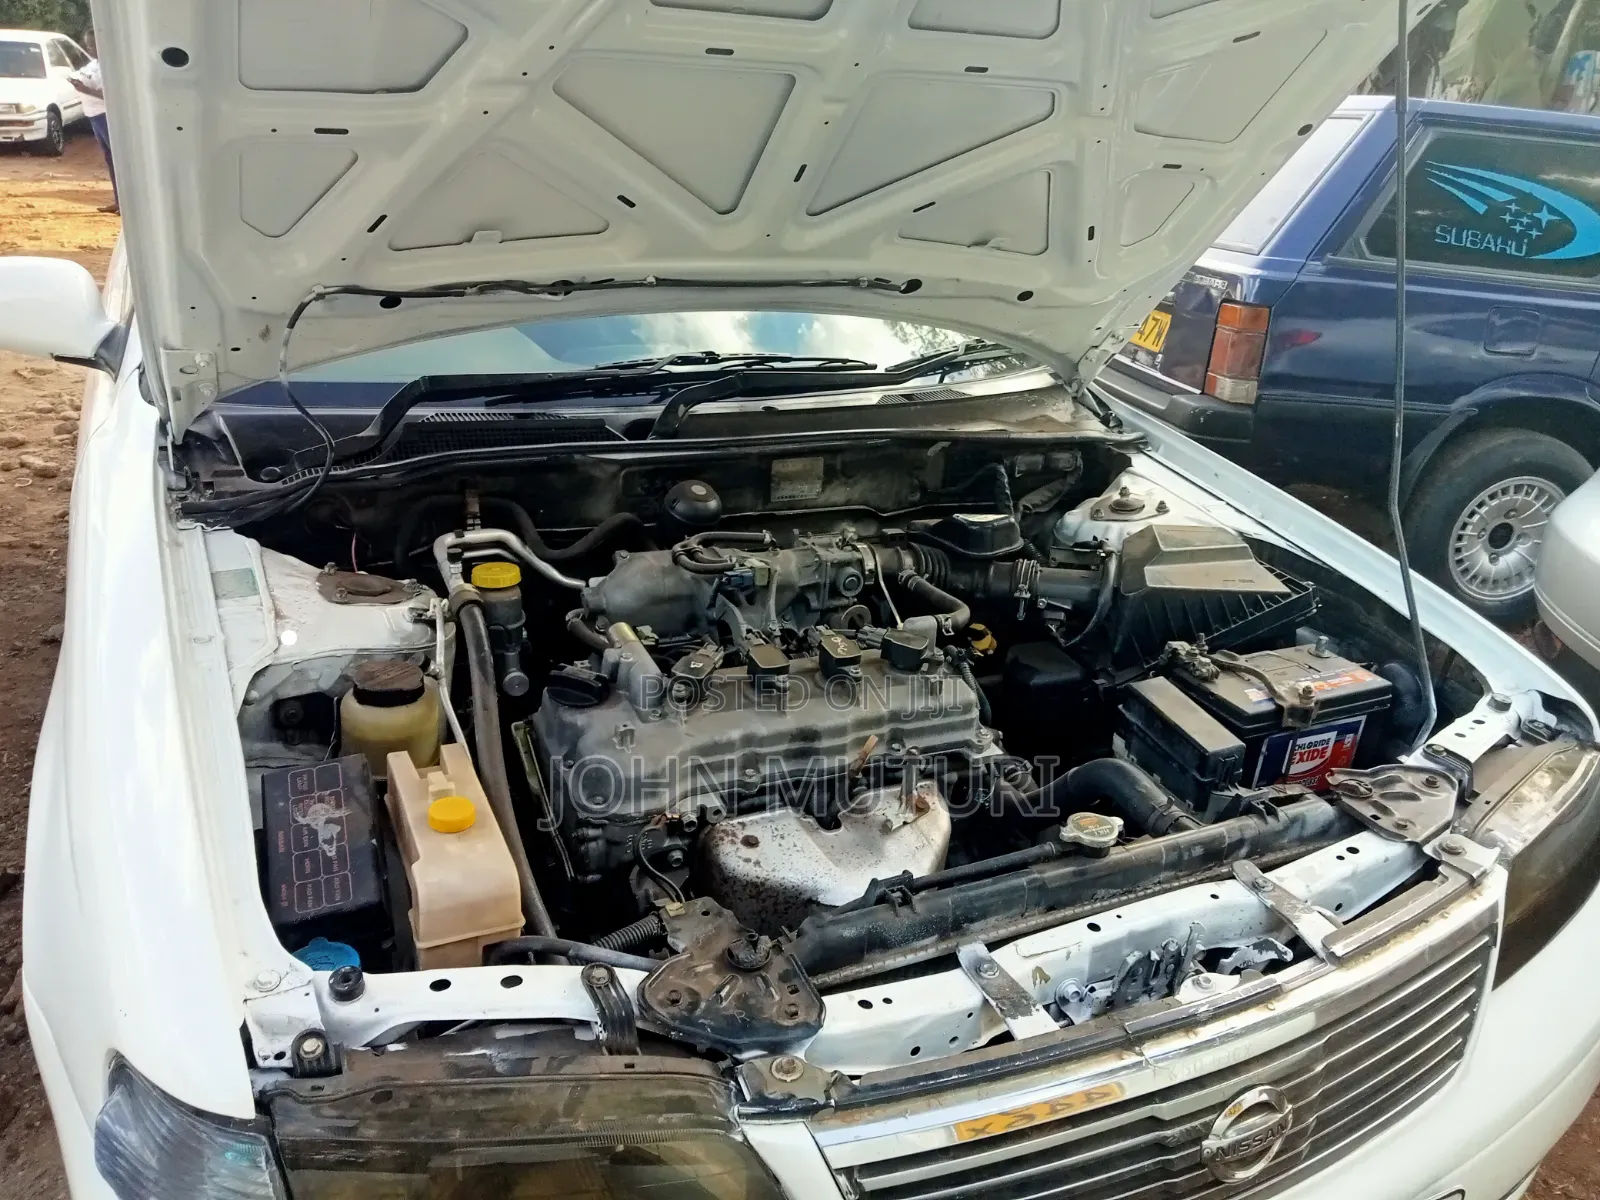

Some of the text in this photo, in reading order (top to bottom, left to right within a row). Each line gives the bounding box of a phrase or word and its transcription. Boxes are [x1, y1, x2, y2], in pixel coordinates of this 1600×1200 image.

[1434, 224, 1528, 257] SUBARU
[1290, 746, 1330, 765] EXIDE
[1215, 1119, 1288, 1161] NISSAN
